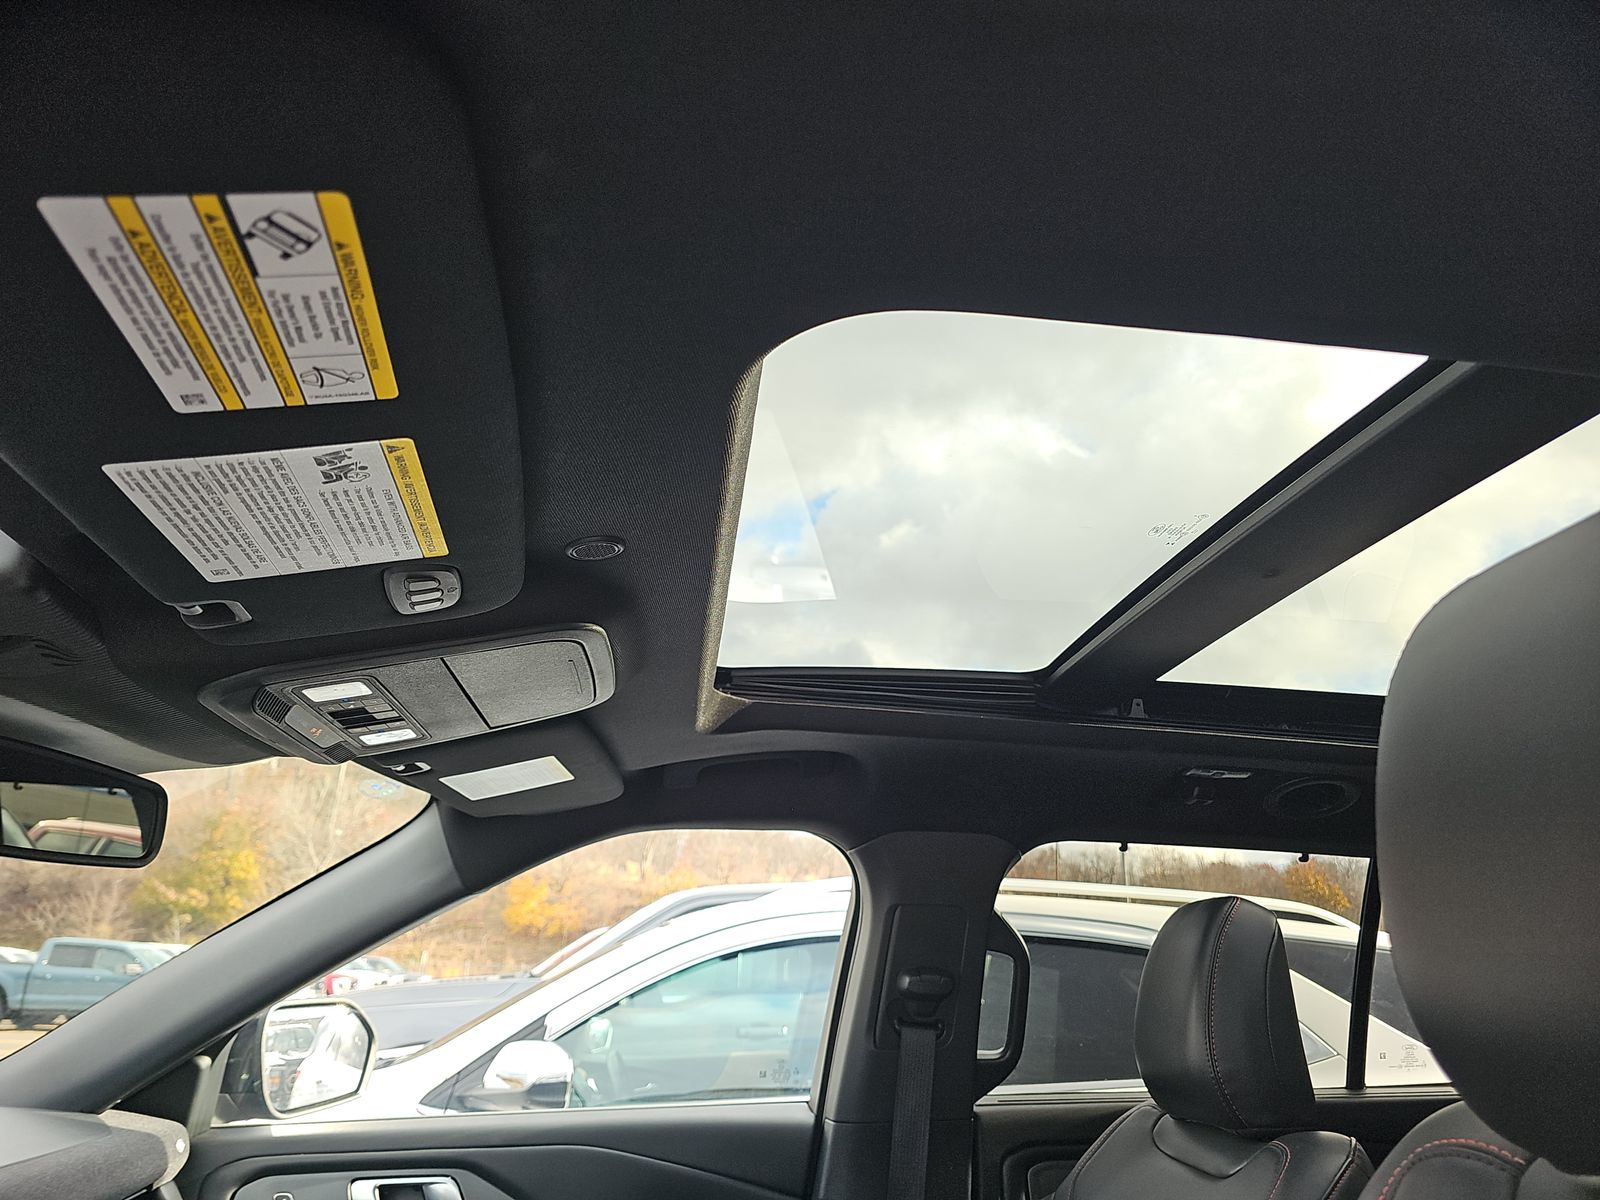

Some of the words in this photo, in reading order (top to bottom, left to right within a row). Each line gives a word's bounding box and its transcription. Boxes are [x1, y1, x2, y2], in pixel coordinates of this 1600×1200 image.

[133, 241, 191, 316] ADVERTENCIA:
[208, 226, 264, 316] AVERTISSEMENT:
[337, 252, 366, 303] WARNING:
[277, 471, 296, 486] AVEC
[285, 484, 302, 496] DES
[380, 488, 394, 501] EVEN
[291, 494, 309, 508] SACS
[392, 454, 412, 481] WARNING
[402, 482, 426, 522] AVERTISSEMENT
[417, 522, 437, 553] ADVERTENCIA
